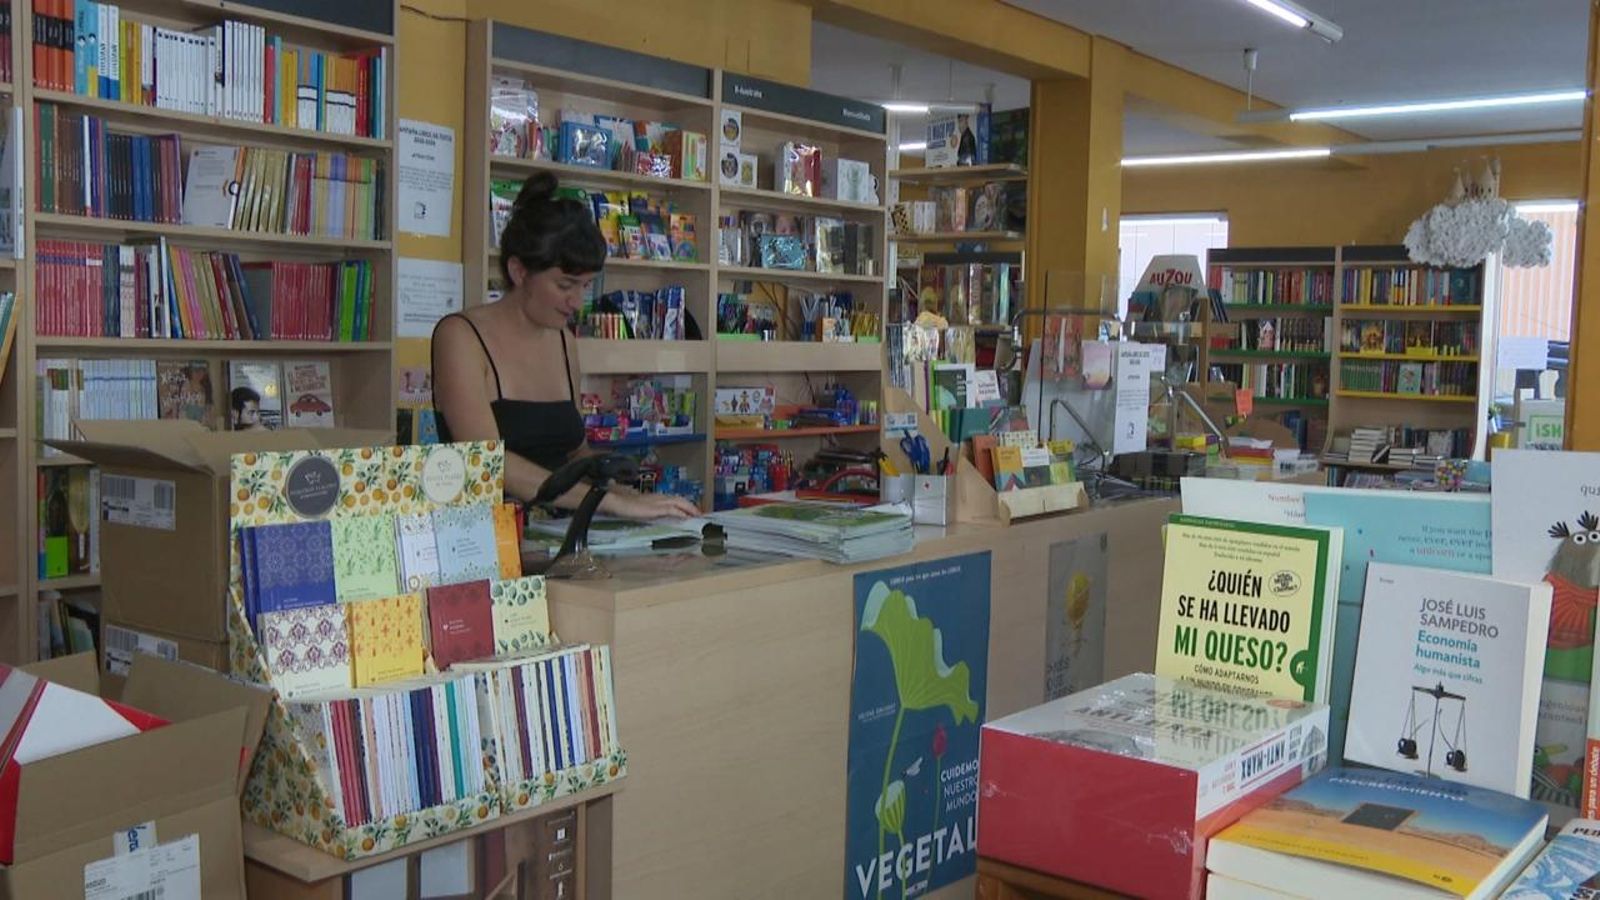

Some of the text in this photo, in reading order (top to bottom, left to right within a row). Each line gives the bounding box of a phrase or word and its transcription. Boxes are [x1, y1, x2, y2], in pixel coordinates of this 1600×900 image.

[1150, 269, 1192, 286] AUZOU
[1208, 569, 1262, 598] ¿QUIÉN
[1177, 595, 1290, 633] SE HA LLEVADO
[1419, 598, 1486, 620] JOSÉ LUIS
[1420, 613, 1499, 638] SAMPEDRO
[1174, 625, 1288, 673] MI QUESO?
[1417, 629, 1478, 653] Economía
[1415, 644, 1481, 669] humanista
[1194, 664, 1260, 685] CÓMO ADAPTARNOS
[940, 759, 978, 782] CUIDEMO
[1240, 740, 1286, 781] ANTI-MARX
[856, 816, 976, 899] VEGETAL
